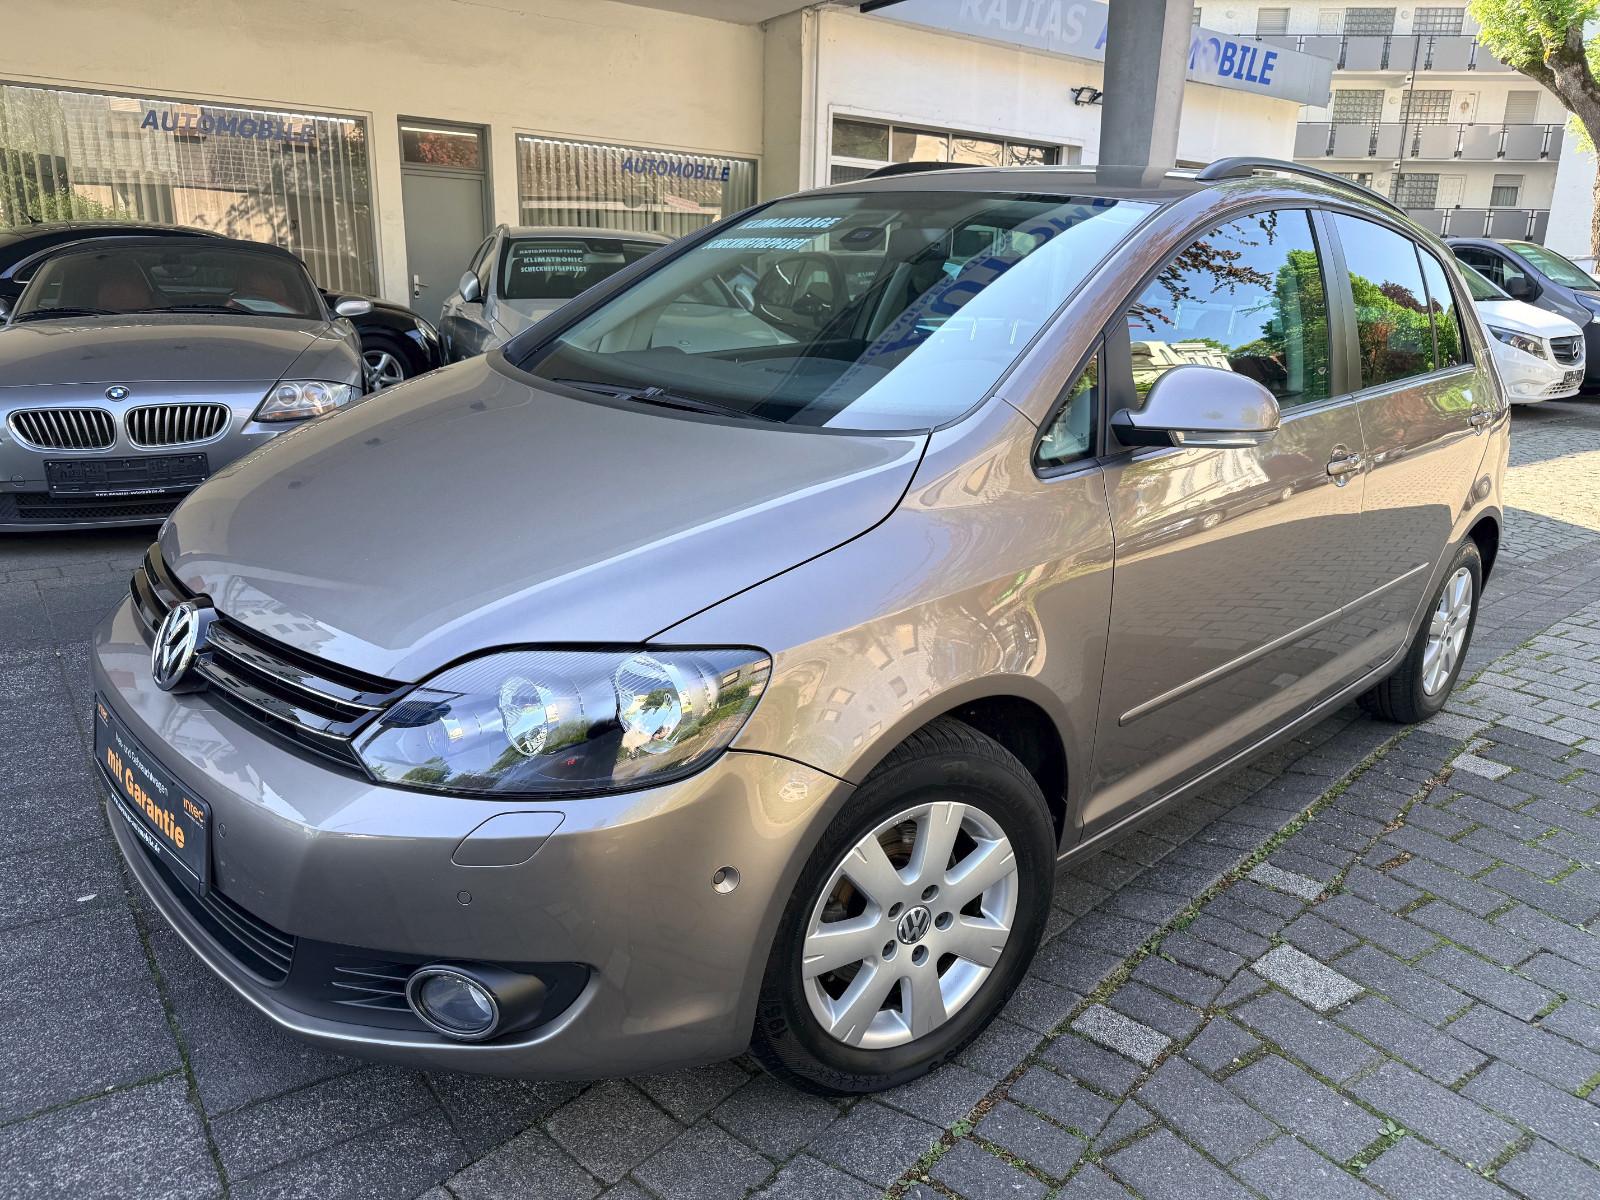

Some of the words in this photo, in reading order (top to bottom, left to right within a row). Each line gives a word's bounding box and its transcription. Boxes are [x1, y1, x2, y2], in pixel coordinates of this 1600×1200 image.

[141, 109, 314, 143] AUTOMOBILE
[622, 156, 730, 182] AUTOMOBILE
[523, 256, 583, 264] KLIMATRONIC
[107, 746, 123, 784] mit
[125, 767, 185, 849] Garantie
